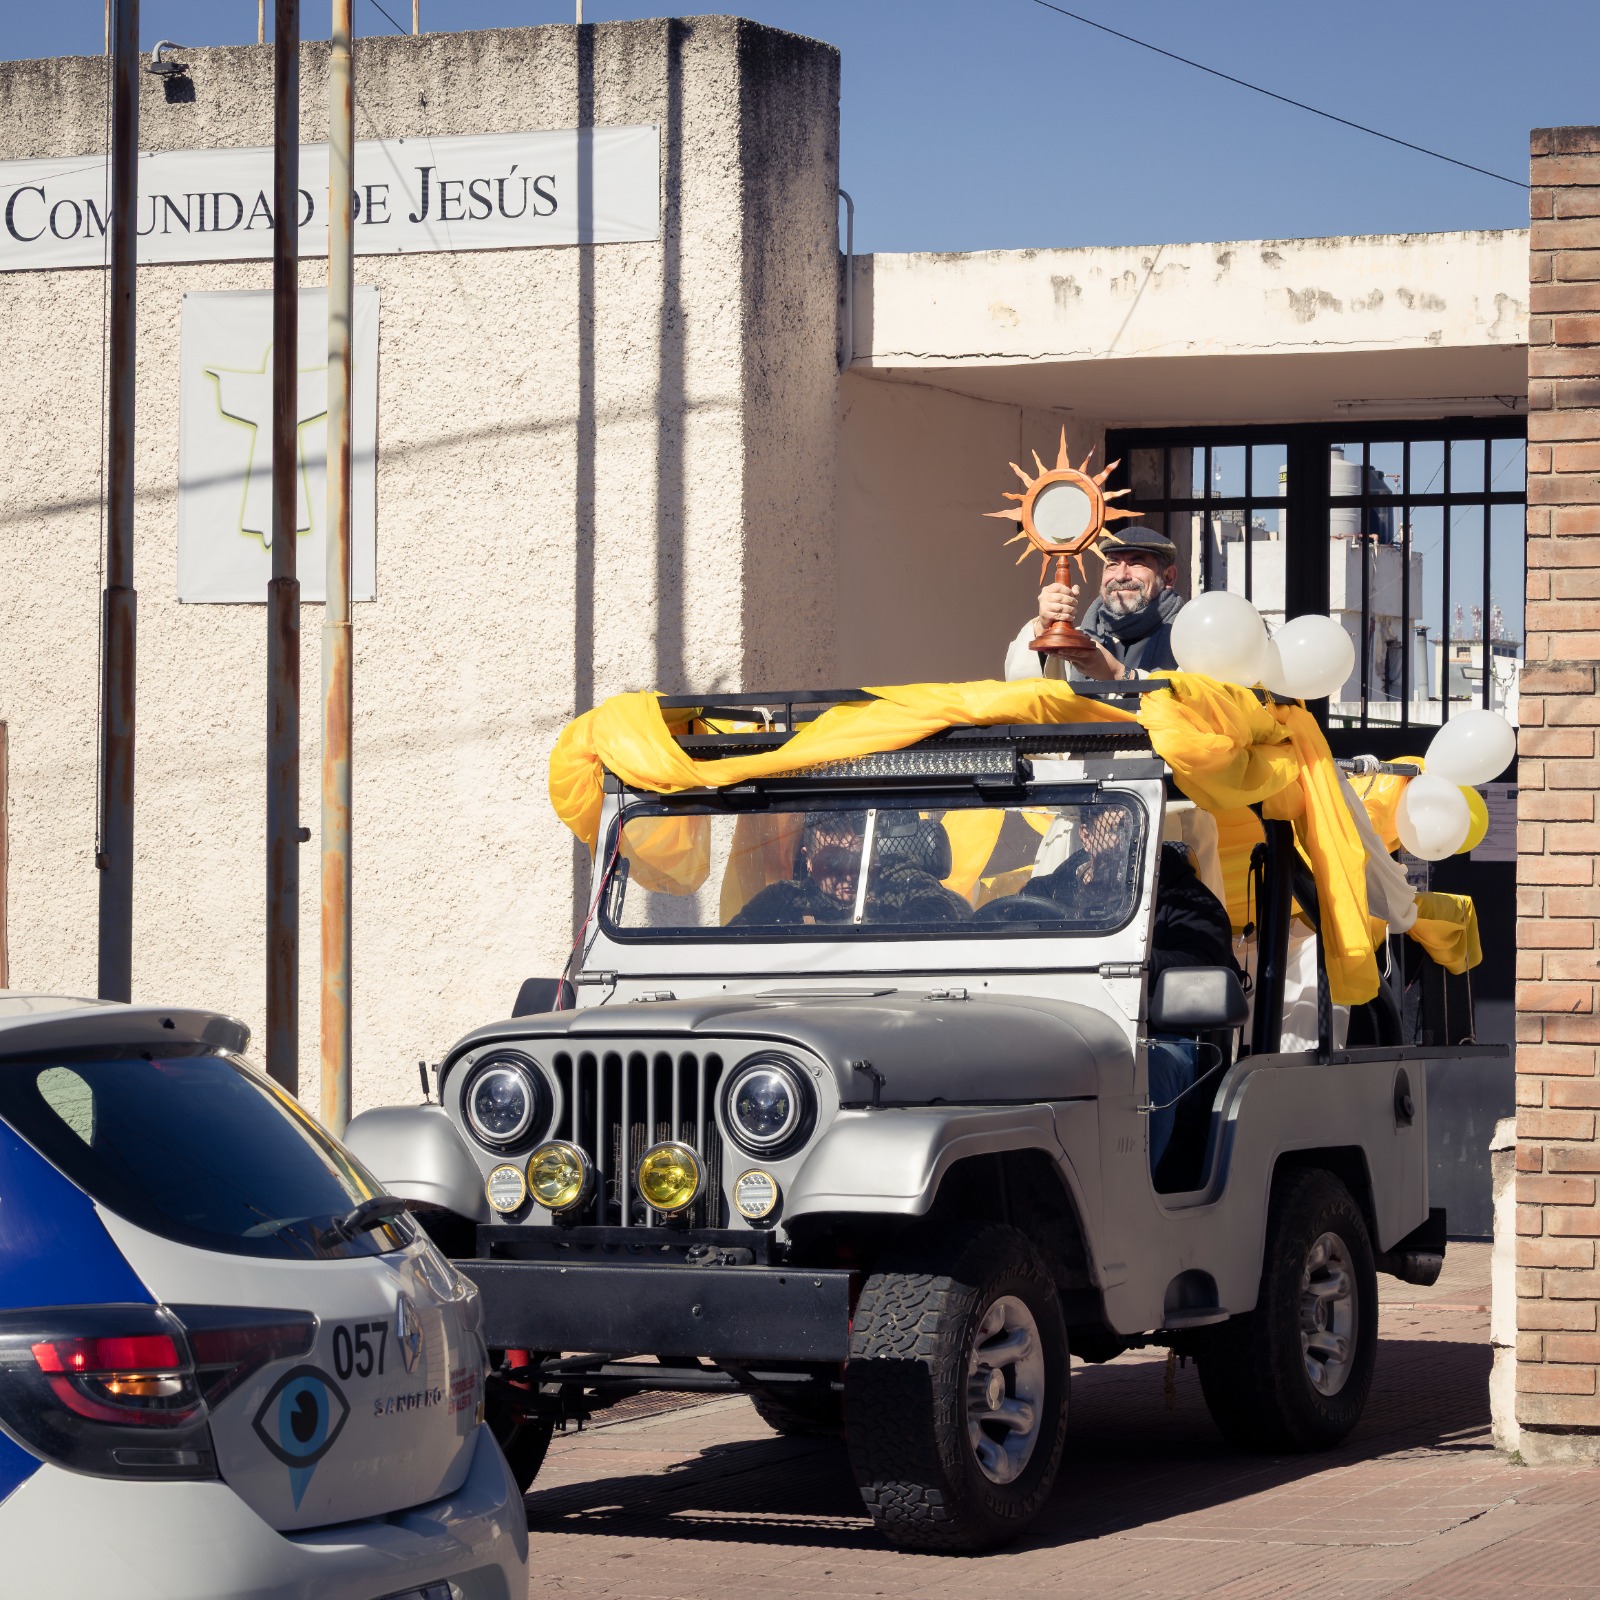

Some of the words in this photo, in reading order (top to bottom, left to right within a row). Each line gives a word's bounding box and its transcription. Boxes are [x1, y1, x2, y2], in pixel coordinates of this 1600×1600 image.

[325, 184, 391, 225] E
[408, 164, 558, 224] JESÚS
[333, 1321, 388, 1380] 057
[374, 1387, 441, 1417] SANDERO
